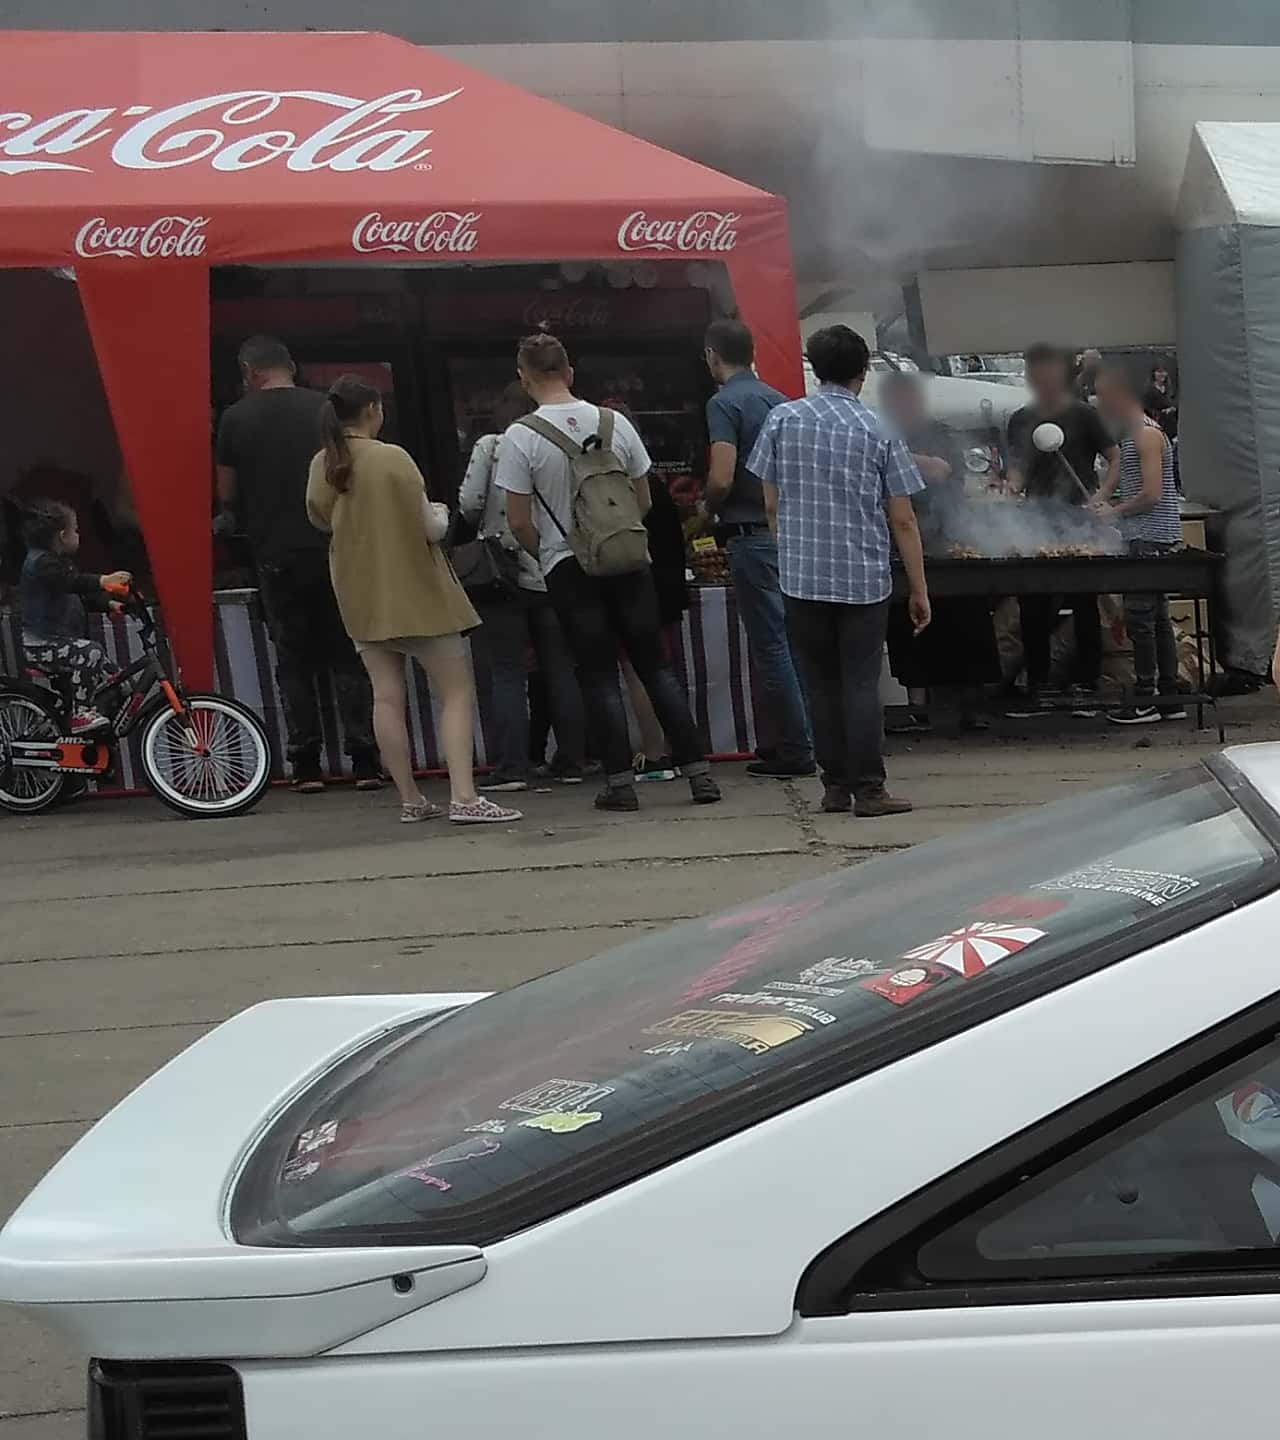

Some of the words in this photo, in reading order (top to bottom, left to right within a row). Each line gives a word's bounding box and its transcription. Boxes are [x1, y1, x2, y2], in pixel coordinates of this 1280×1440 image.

[0, 87, 464, 175] ca-Cola
[75, 215, 212, 258] Coca-Cola
[352, 211, 482, 253] Coca-Cola
[617, 211, 741, 252] Coca-Cola
